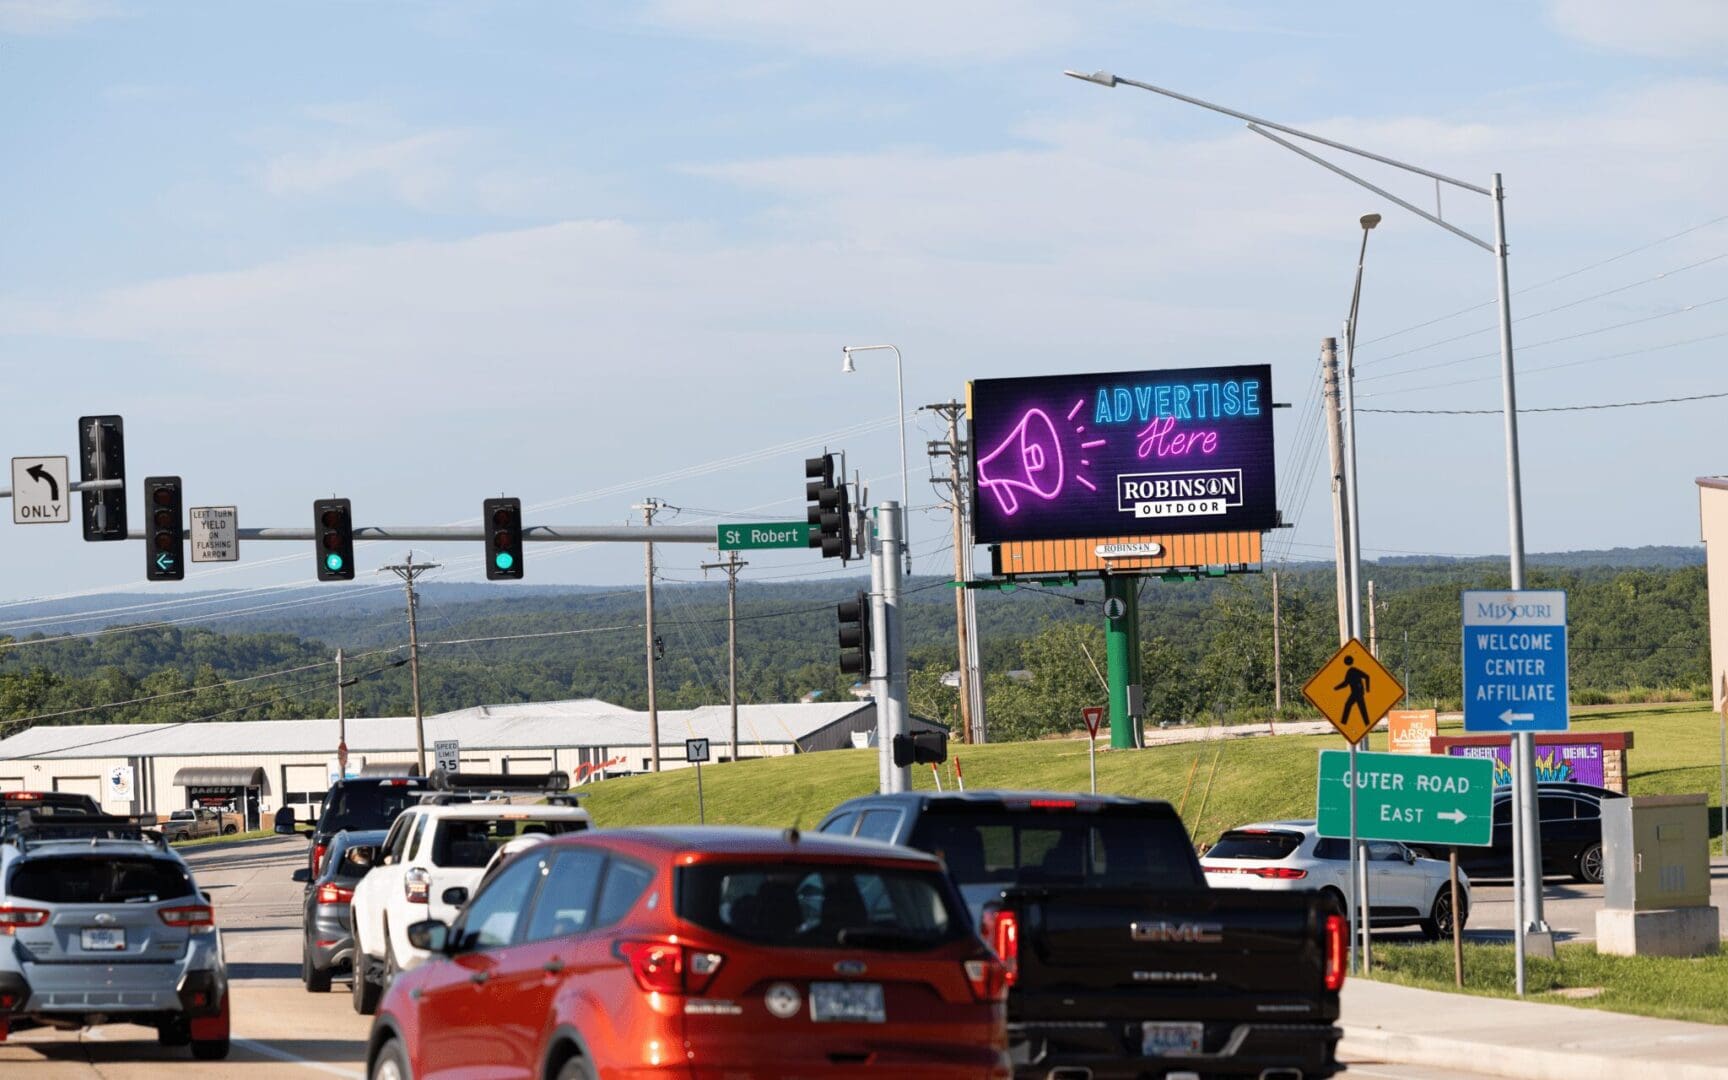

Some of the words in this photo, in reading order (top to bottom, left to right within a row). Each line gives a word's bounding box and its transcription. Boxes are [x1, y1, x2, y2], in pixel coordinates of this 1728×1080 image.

[1095, 381, 1260, 422] ADVERTISE
[1137, 416, 1217, 457] Here
[1124, 477, 1236, 499] ROBINSON
[21, 505, 61, 518] ONLY
[193, 511, 210, 519] LEFT
[214, 510, 233, 518] TURN
[1143, 502, 1219, 515] OUTDOOR
[201, 520, 226, 529] YIELD
[726, 531, 741, 544] St
[751, 528, 798, 543] Robert
[196, 541, 232, 549] FLASHING
[1104, 543, 1150, 553] ROBINSON
[202, 550, 227, 558] ARROW
[1477, 634, 1553, 651] WELCOME
[1485, 659, 1545, 676] CENTER
[1477, 684, 1555, 701] AFFILIATE
[1393, 728, 1436, 741] LARSON
[693, 744, 702, 756] Y
[1463, 747, 1499, 758] GREAT
[1562, 747, 1598, 759] DEALS
[439, 760, 457, 770] 35
[1343, 771, 1404, 791] OUTER
[1416, 775, 1470, 794] ROAD
[1380, 804, 1424, 823] EAST
[1130, 922, 1223, 942] GMC
